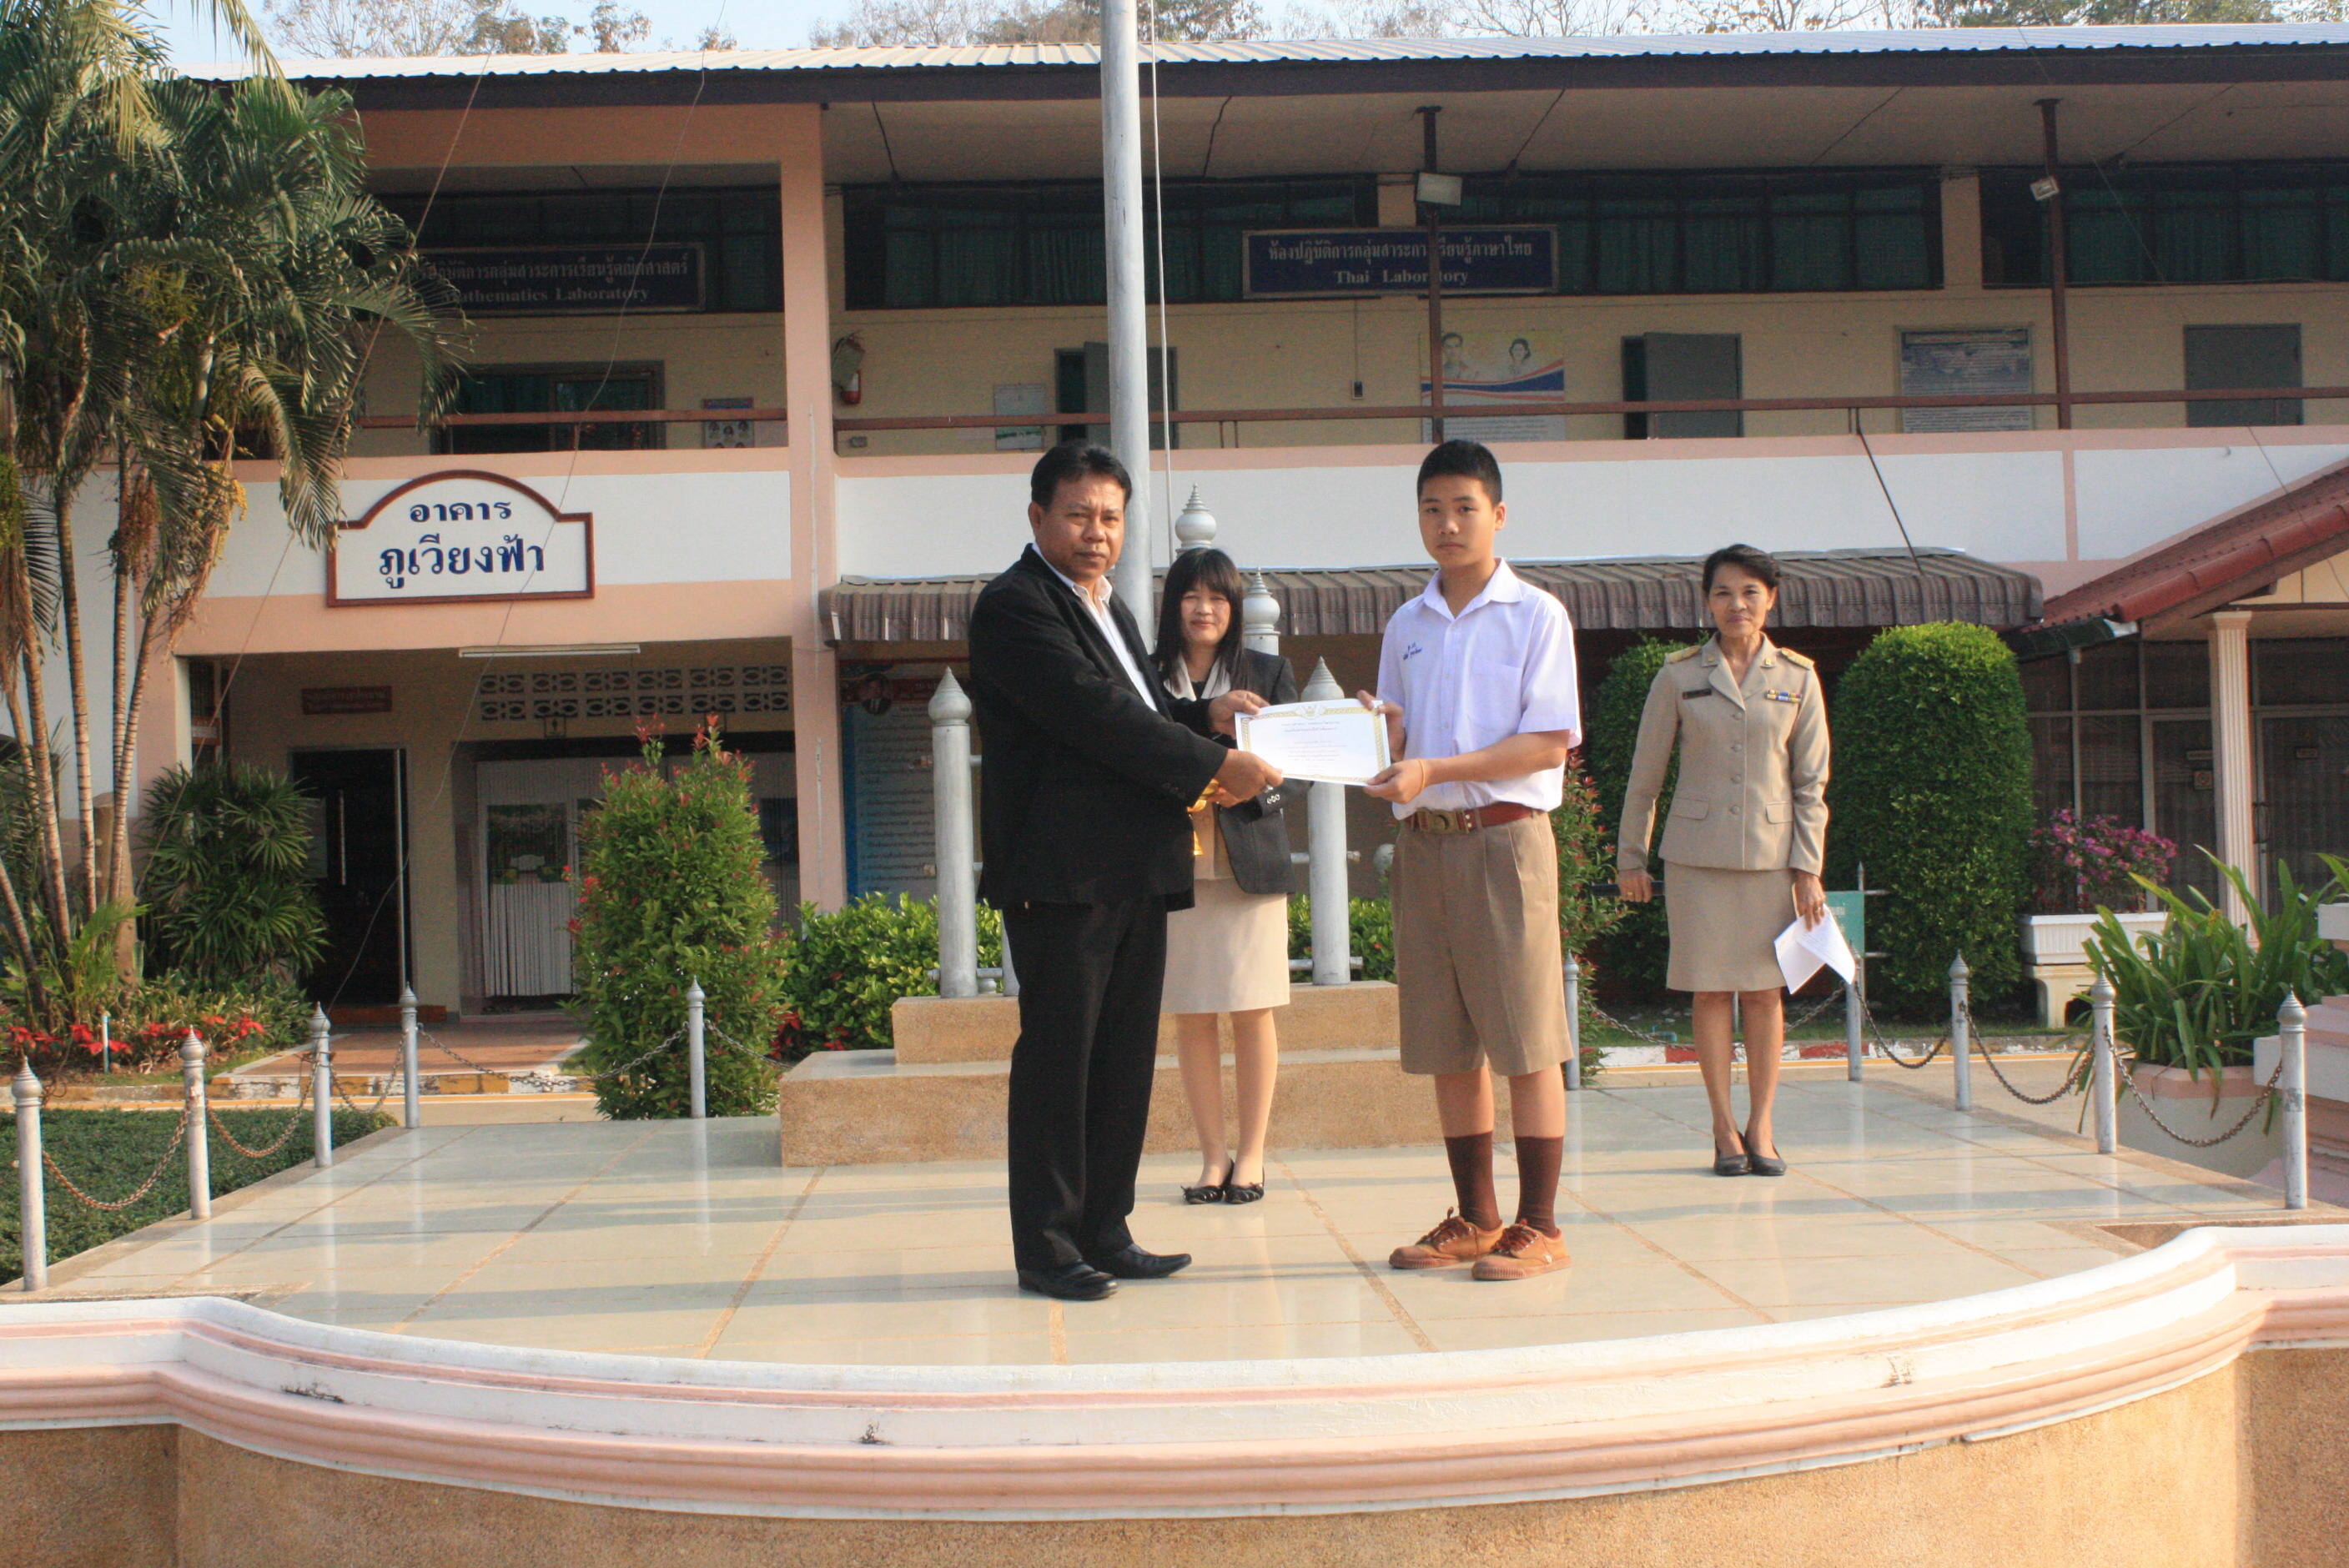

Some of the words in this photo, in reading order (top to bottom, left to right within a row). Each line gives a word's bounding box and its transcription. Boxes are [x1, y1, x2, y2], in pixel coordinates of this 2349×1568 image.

[1268, 235, 1532, 265] ห้องปฏิบัติการกลุ่มสาระการียนรู้ภาษาไทย
[1334, 269, 1370, 284] Thai
[1382, 269, 1468, 286] Labortory
[556, 286, 650, 303] Laboratory
[410, 500, 512, 522] อาคาร
[379, 532, 545, 589] ภูเวียงฟ้า
